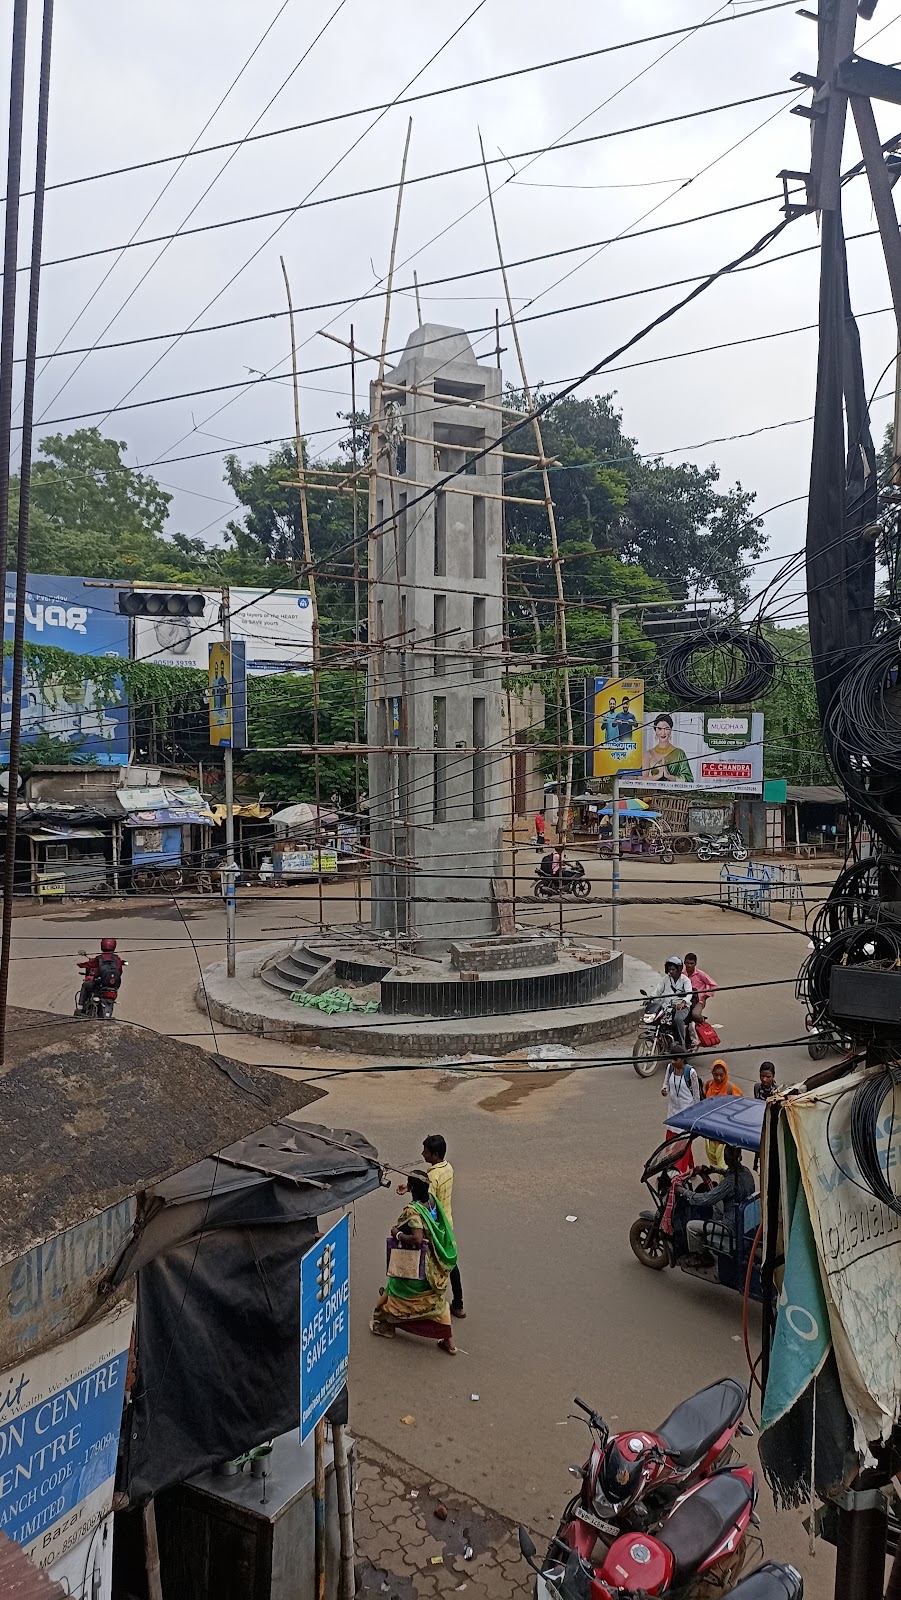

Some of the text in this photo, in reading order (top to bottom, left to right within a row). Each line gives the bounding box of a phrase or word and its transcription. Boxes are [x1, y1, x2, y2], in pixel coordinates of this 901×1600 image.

[302, 1278, 349, 1352] SAFE DRIVE
[306, 1331, 327, 1373] SAVE
[328, 1310, 344, 1346] LIFE
[48, 1382, 62, 1393] We
[64, 1360, 97, 1383] Manage
[98, 1348, 116, 1363] Both
[35, 1359, 120, 1434] CENTRE
[41, 1461, 74, 1497] CODE
[13, 1496, 65, 1543] LIMITED
[43, 1506, 85, 1549] Bazar
